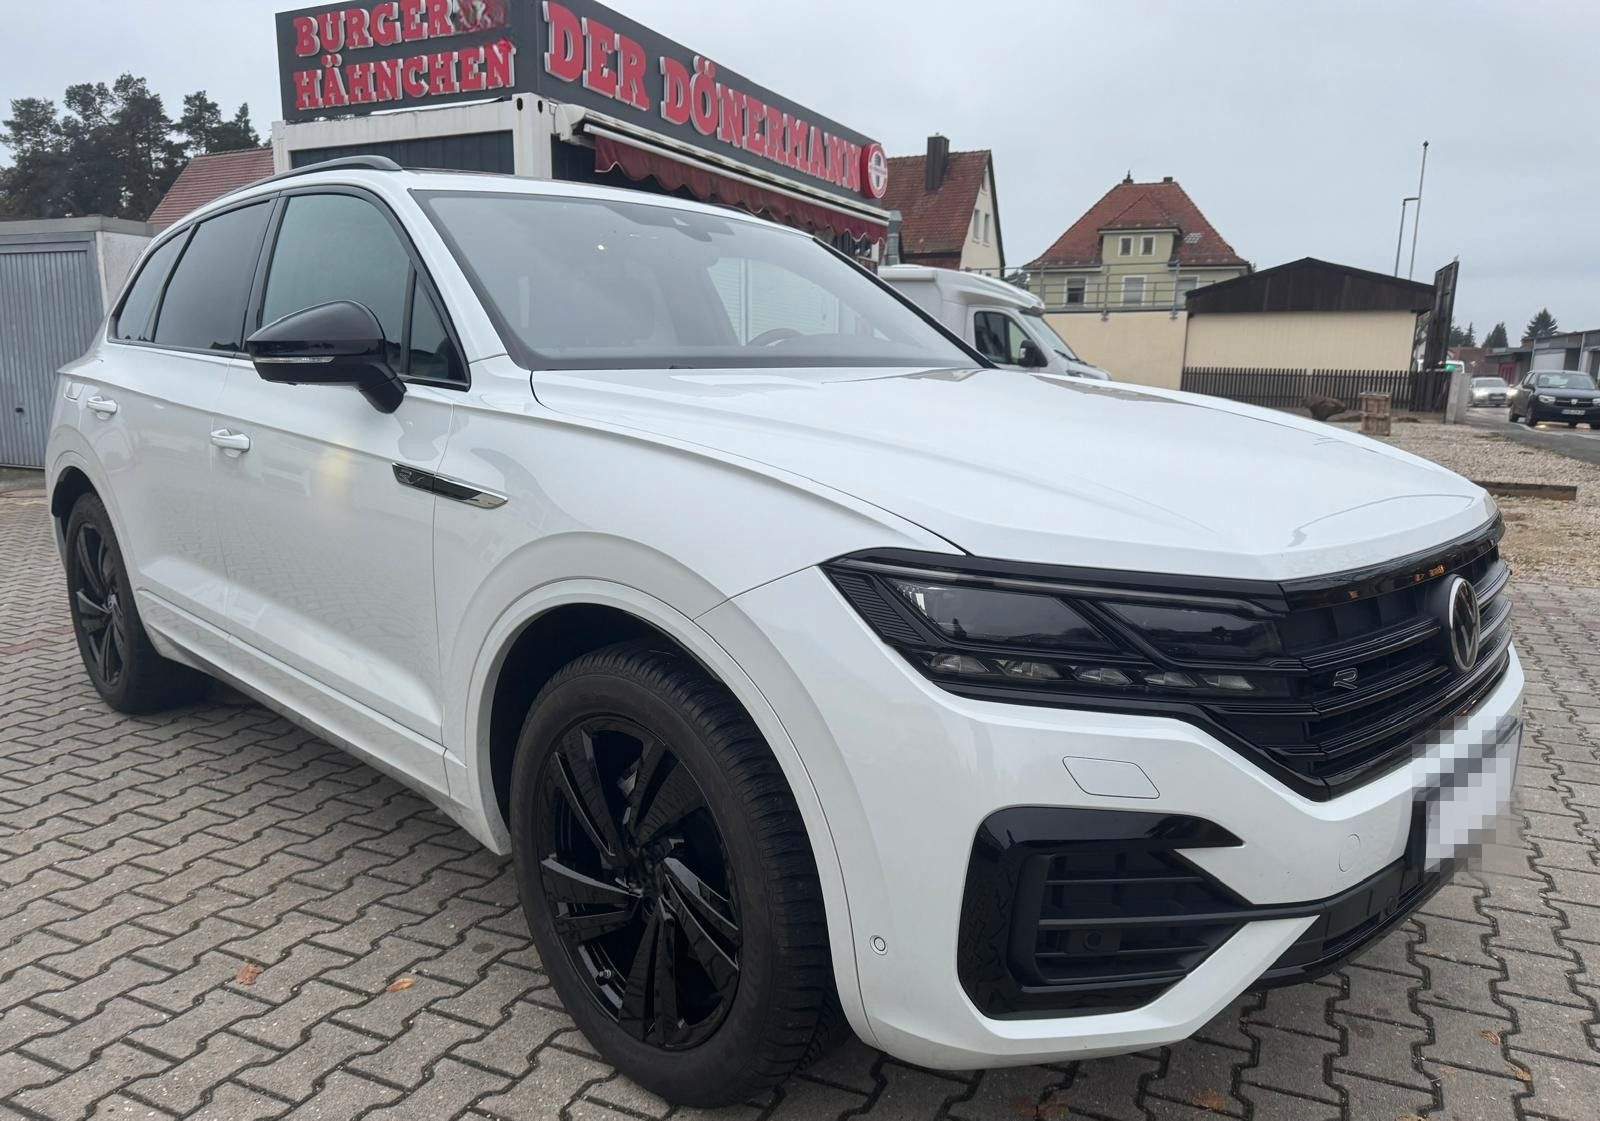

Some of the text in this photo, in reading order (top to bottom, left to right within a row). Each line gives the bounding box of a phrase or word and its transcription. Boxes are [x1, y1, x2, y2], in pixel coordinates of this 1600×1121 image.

[293, 0, 456, 57] BURGER
[293, 40, 516, 111] HÄHNCHEN
[542, 0, 862, 193] DER DÖNERMANN
[1333, 667, 1359, 690] R
